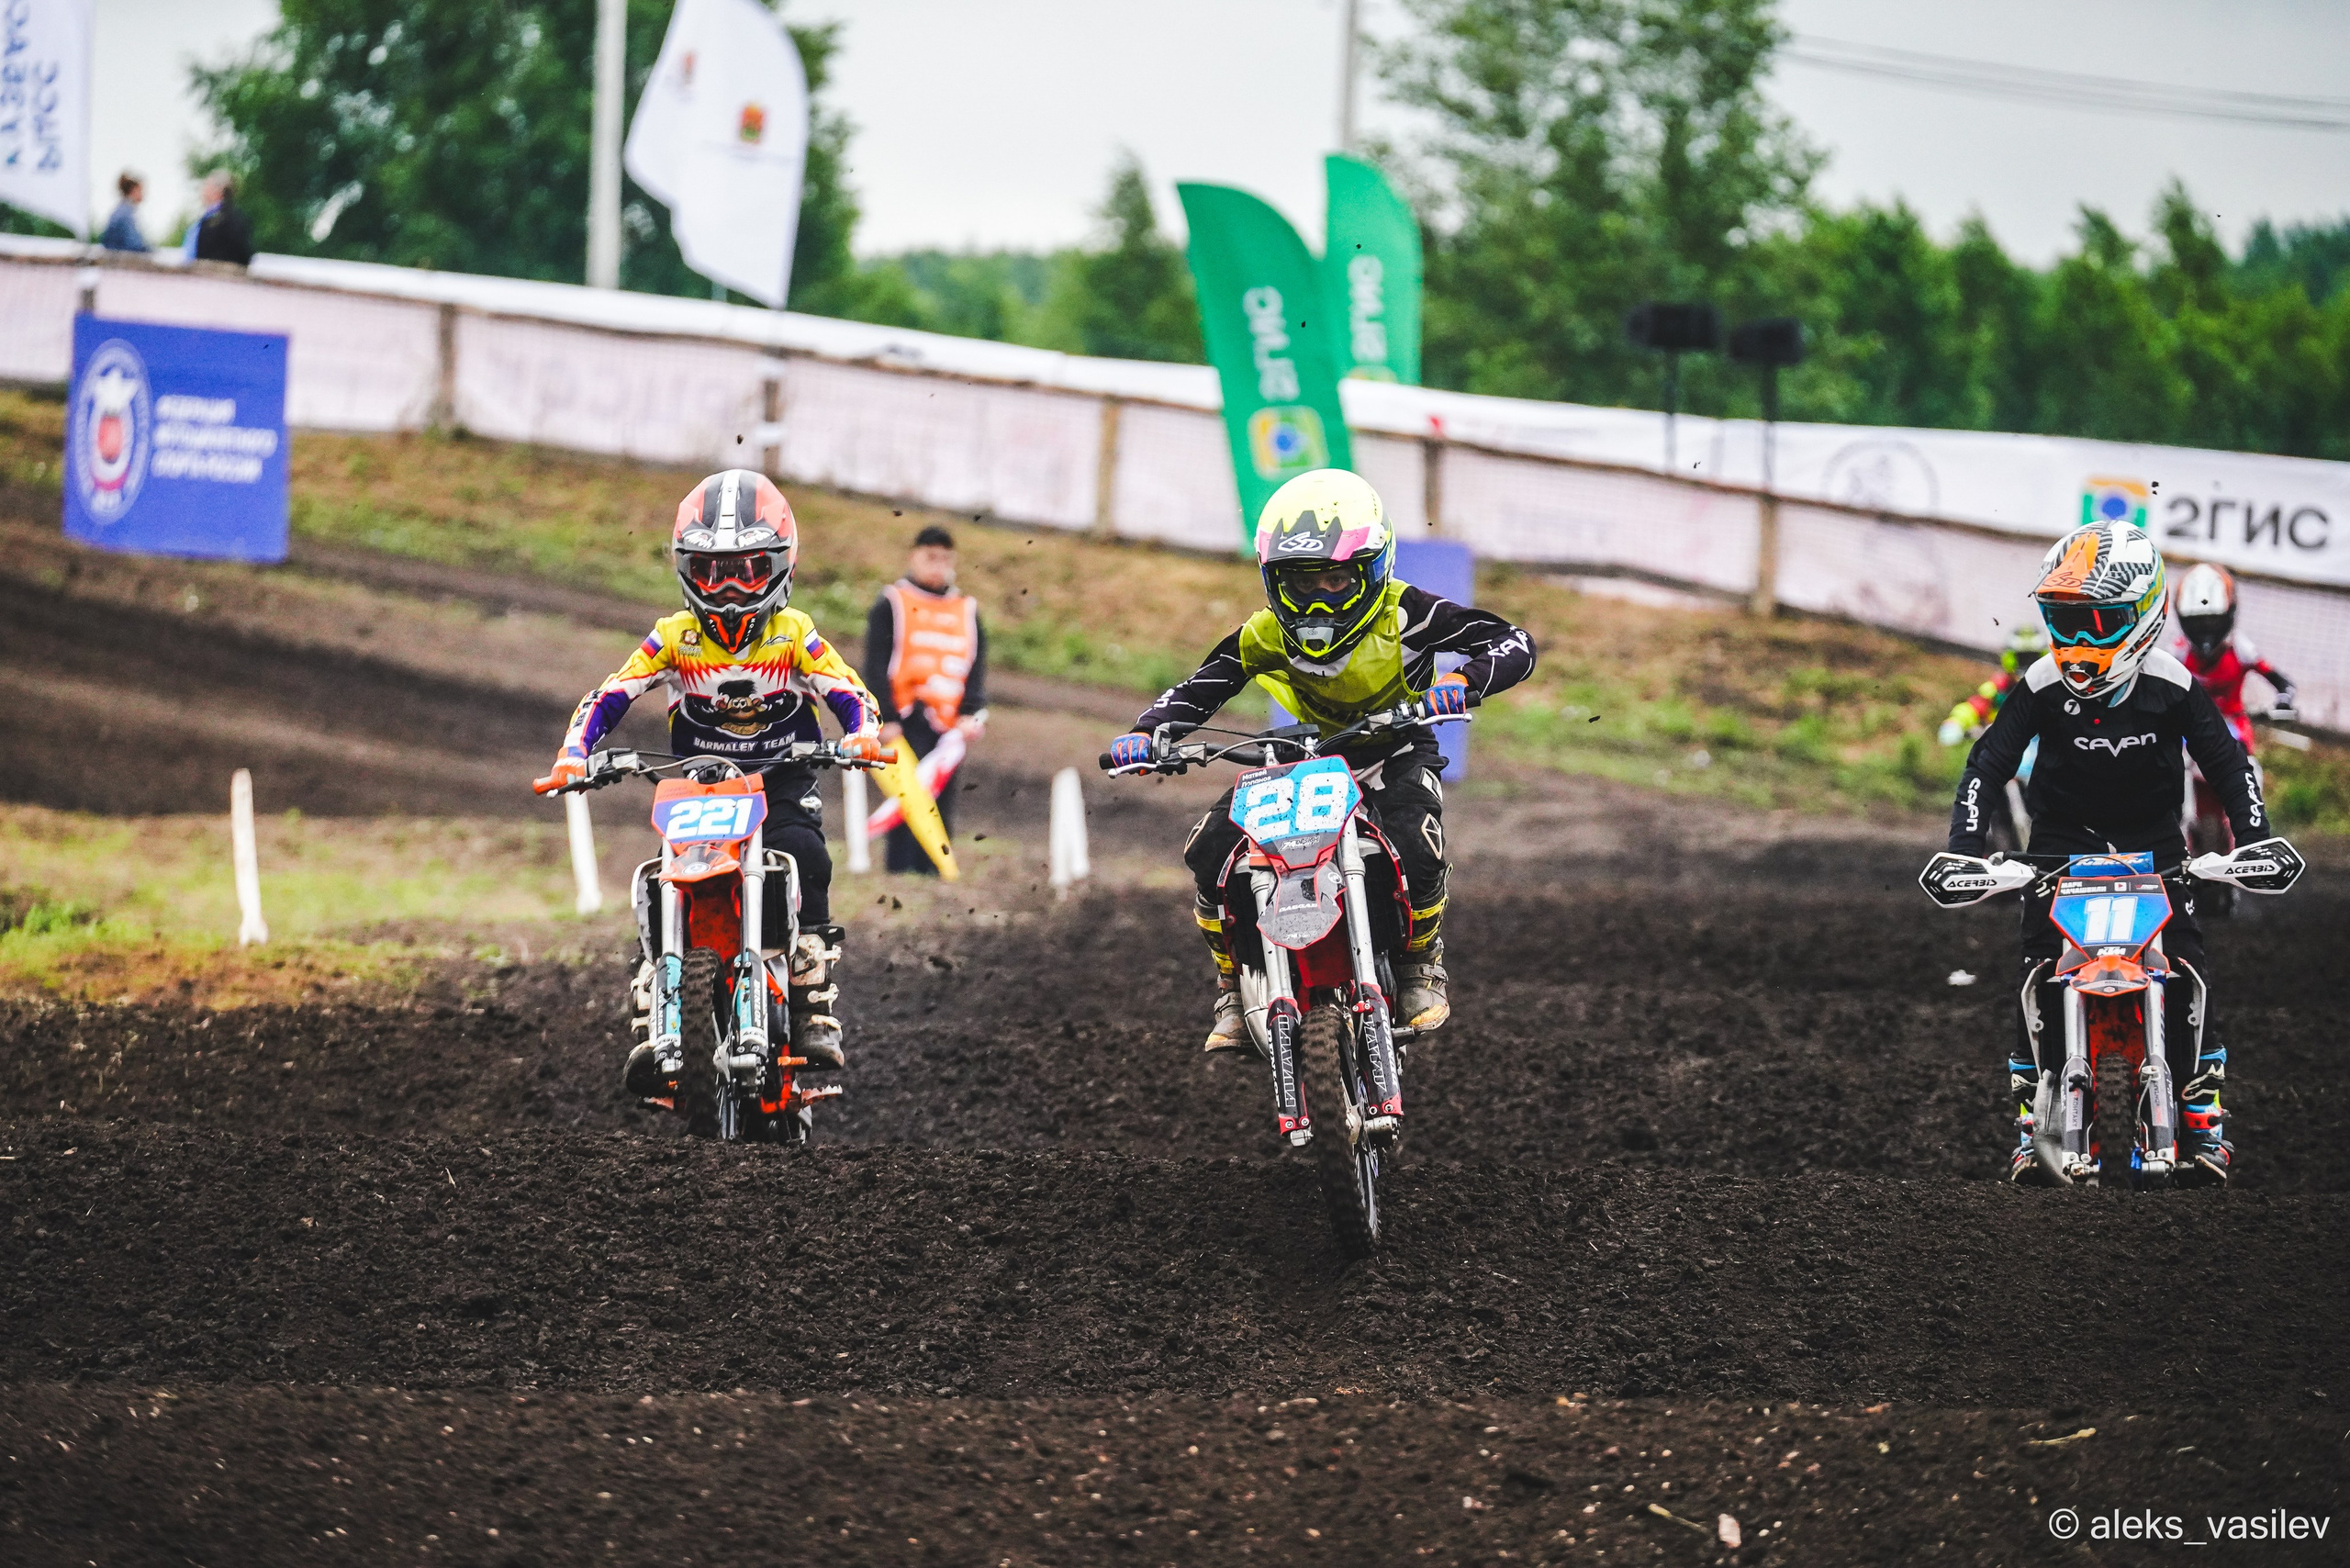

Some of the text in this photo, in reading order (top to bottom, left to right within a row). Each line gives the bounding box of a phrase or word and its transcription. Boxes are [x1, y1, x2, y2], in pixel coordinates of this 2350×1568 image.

[2166, 497, 2330, 550] 2ГИС
[2067, 701, 2077, 713] 7
[694, 730, 797, 752] BARMALEY TEAM
[666, 798, 754, 839] 221
[1244, 772, 1349, 842] 28
[2084, 896, 2138, 944] 11
[2097, 946, 2126, 956] KTM
[754, 979, 762, 1028] DUNLOP
[1380, 1006, 1401, 1090] DUNLOP
